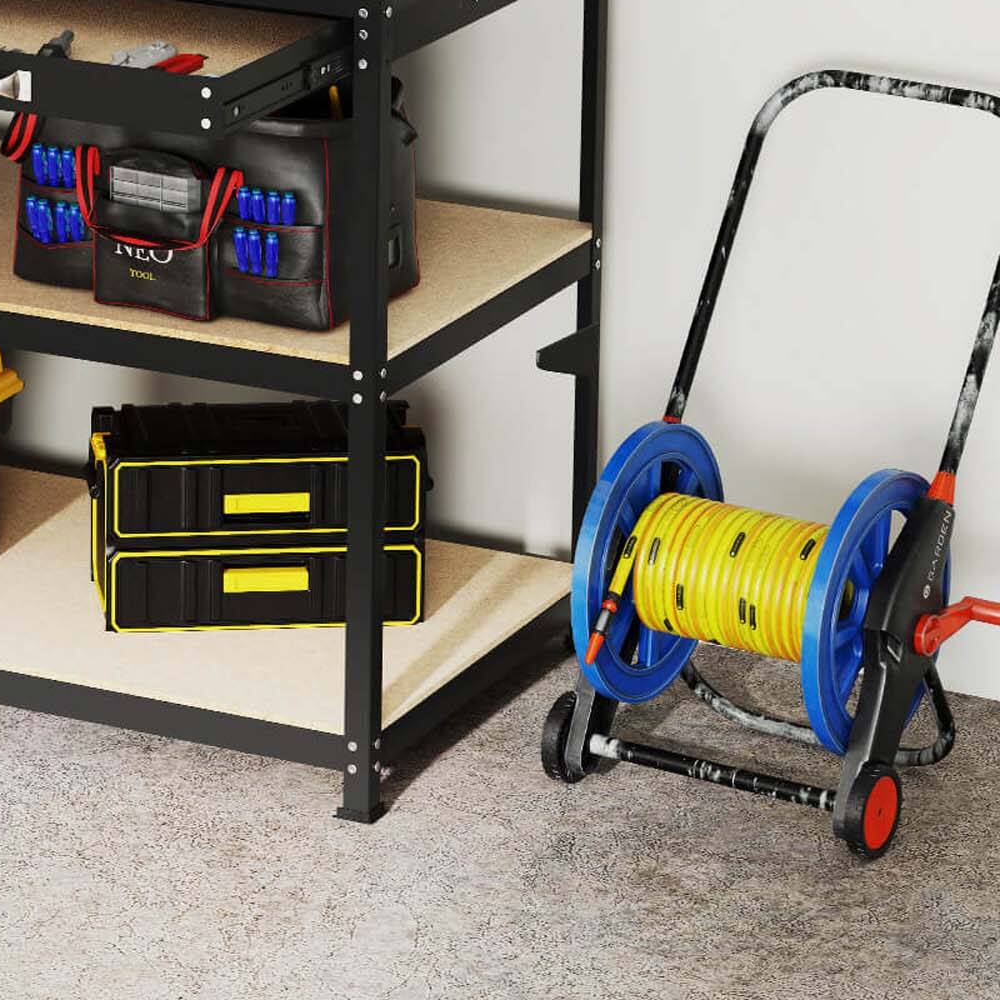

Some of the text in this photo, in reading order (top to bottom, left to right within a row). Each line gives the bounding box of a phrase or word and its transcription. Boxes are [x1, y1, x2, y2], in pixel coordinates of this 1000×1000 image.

[114, 243, 173, 263] NEO
[129, 268, 157, 280] TOOL
[928, 509, 953, 582] GARDEN
